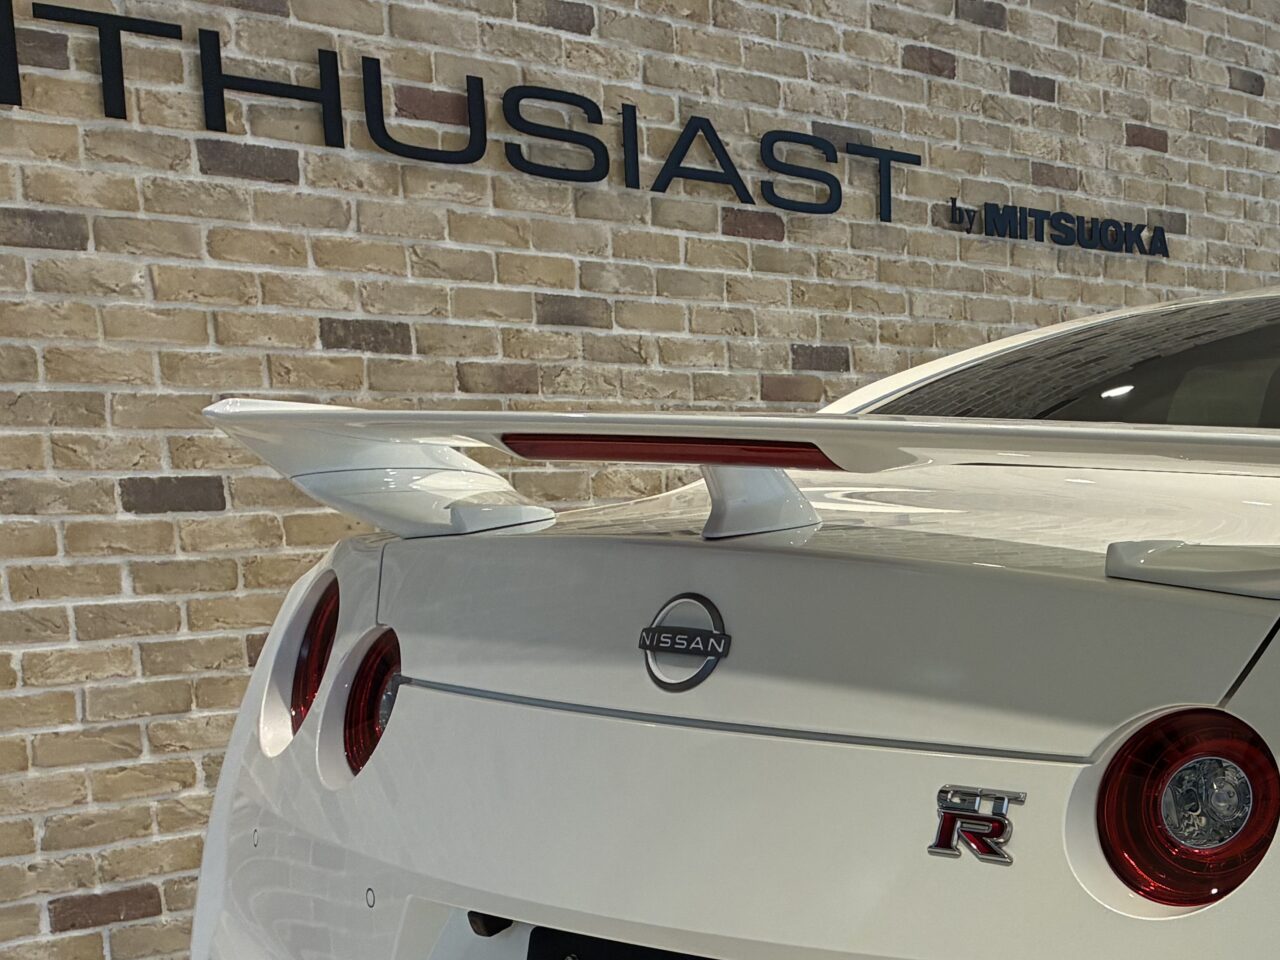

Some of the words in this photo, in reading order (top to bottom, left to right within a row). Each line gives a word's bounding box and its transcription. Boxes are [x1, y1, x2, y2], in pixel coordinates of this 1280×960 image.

[0, 0, 921, 222] THUSIAST
[949, 197, 977, 234] by
[984, 203, 1169, 257] MITSUOKA
[640, 631, 725, 653] NISSAN
